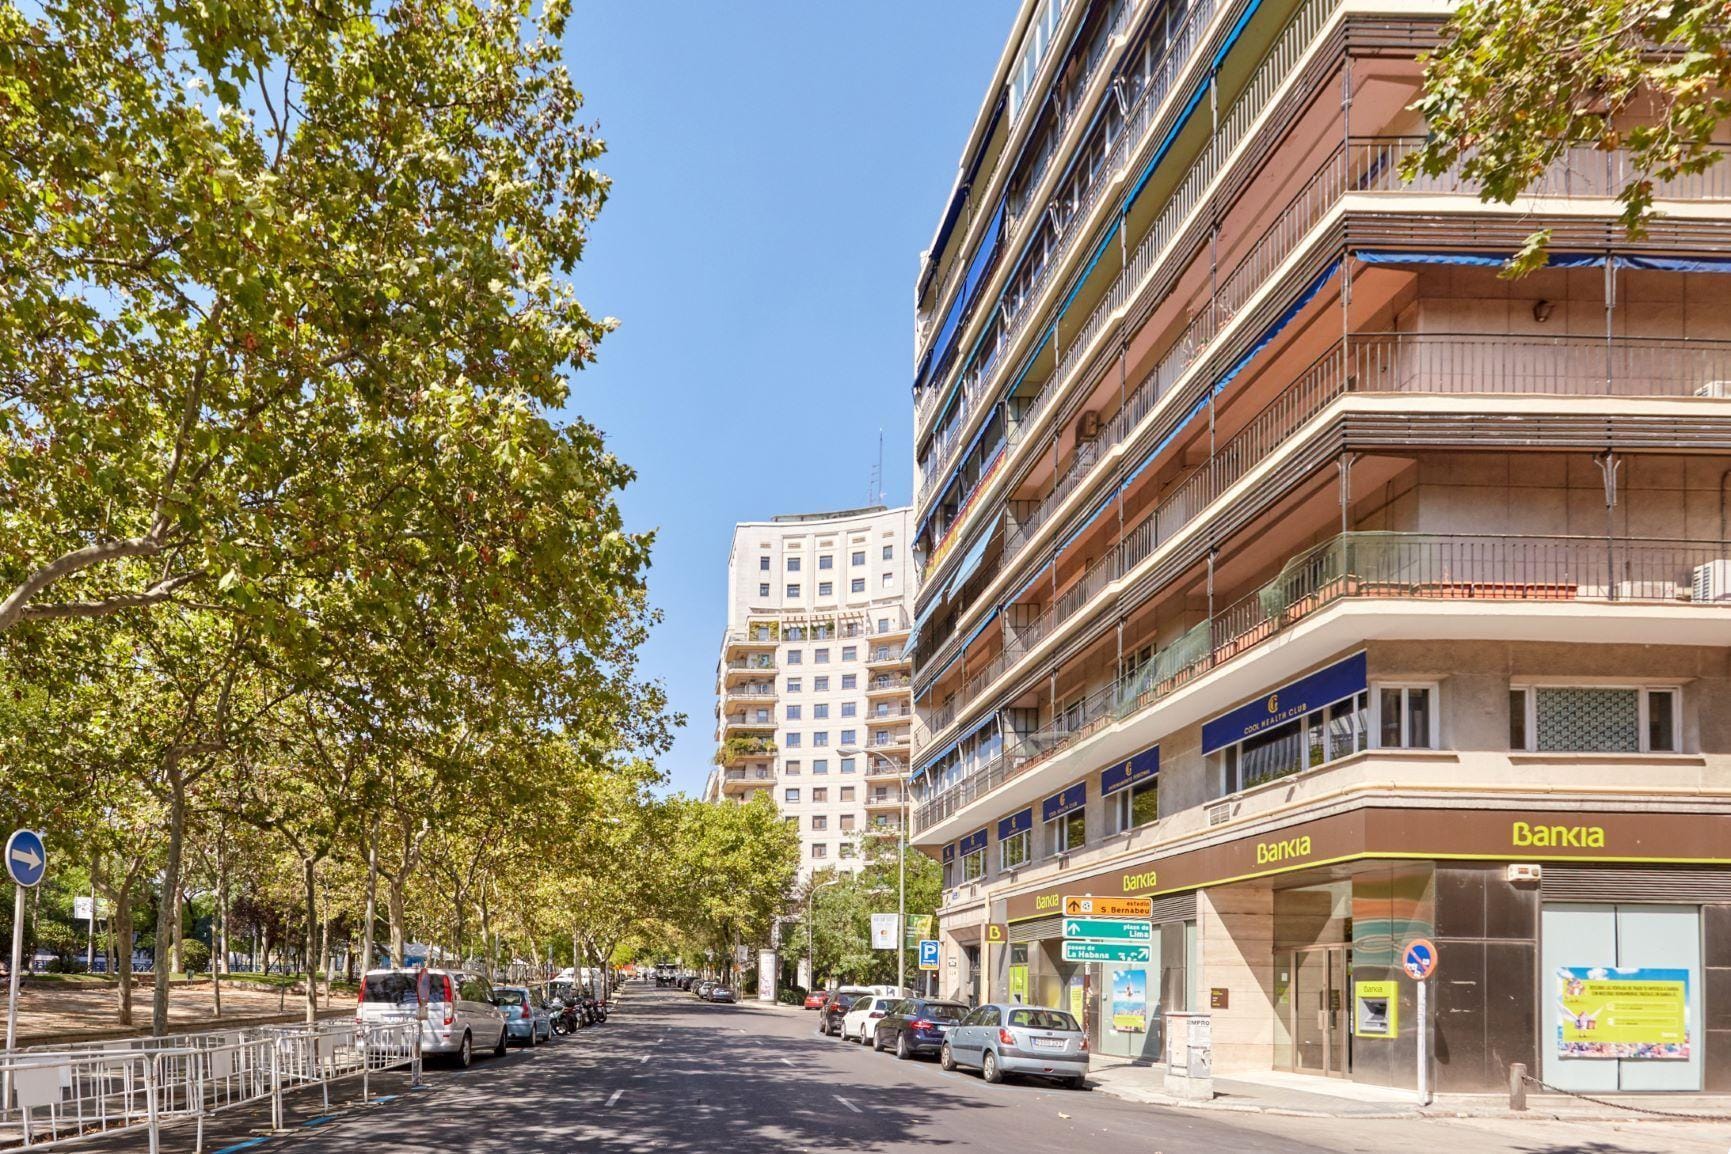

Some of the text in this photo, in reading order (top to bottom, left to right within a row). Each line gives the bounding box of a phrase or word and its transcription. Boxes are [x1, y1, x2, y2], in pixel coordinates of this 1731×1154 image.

[1243, 702, 1307, 735] COOL HEALTH CLUB
[1512, 822, 1605, 847] Bankia
[1257, 835, 1311, 864] Bankia
[1123, 871, 1157, 891] Bankia
[1036, 894, 1059, 909] Bankia
[989, 926, 1001, 939] B
[1123, 923, 1140, 931] plaza
[1129, 930, 1149, 938] Lima
[925, 945, 937, 959] P
[1067, 950, 1077, 958] La
[1078, 950, 1110, 959] Habana
